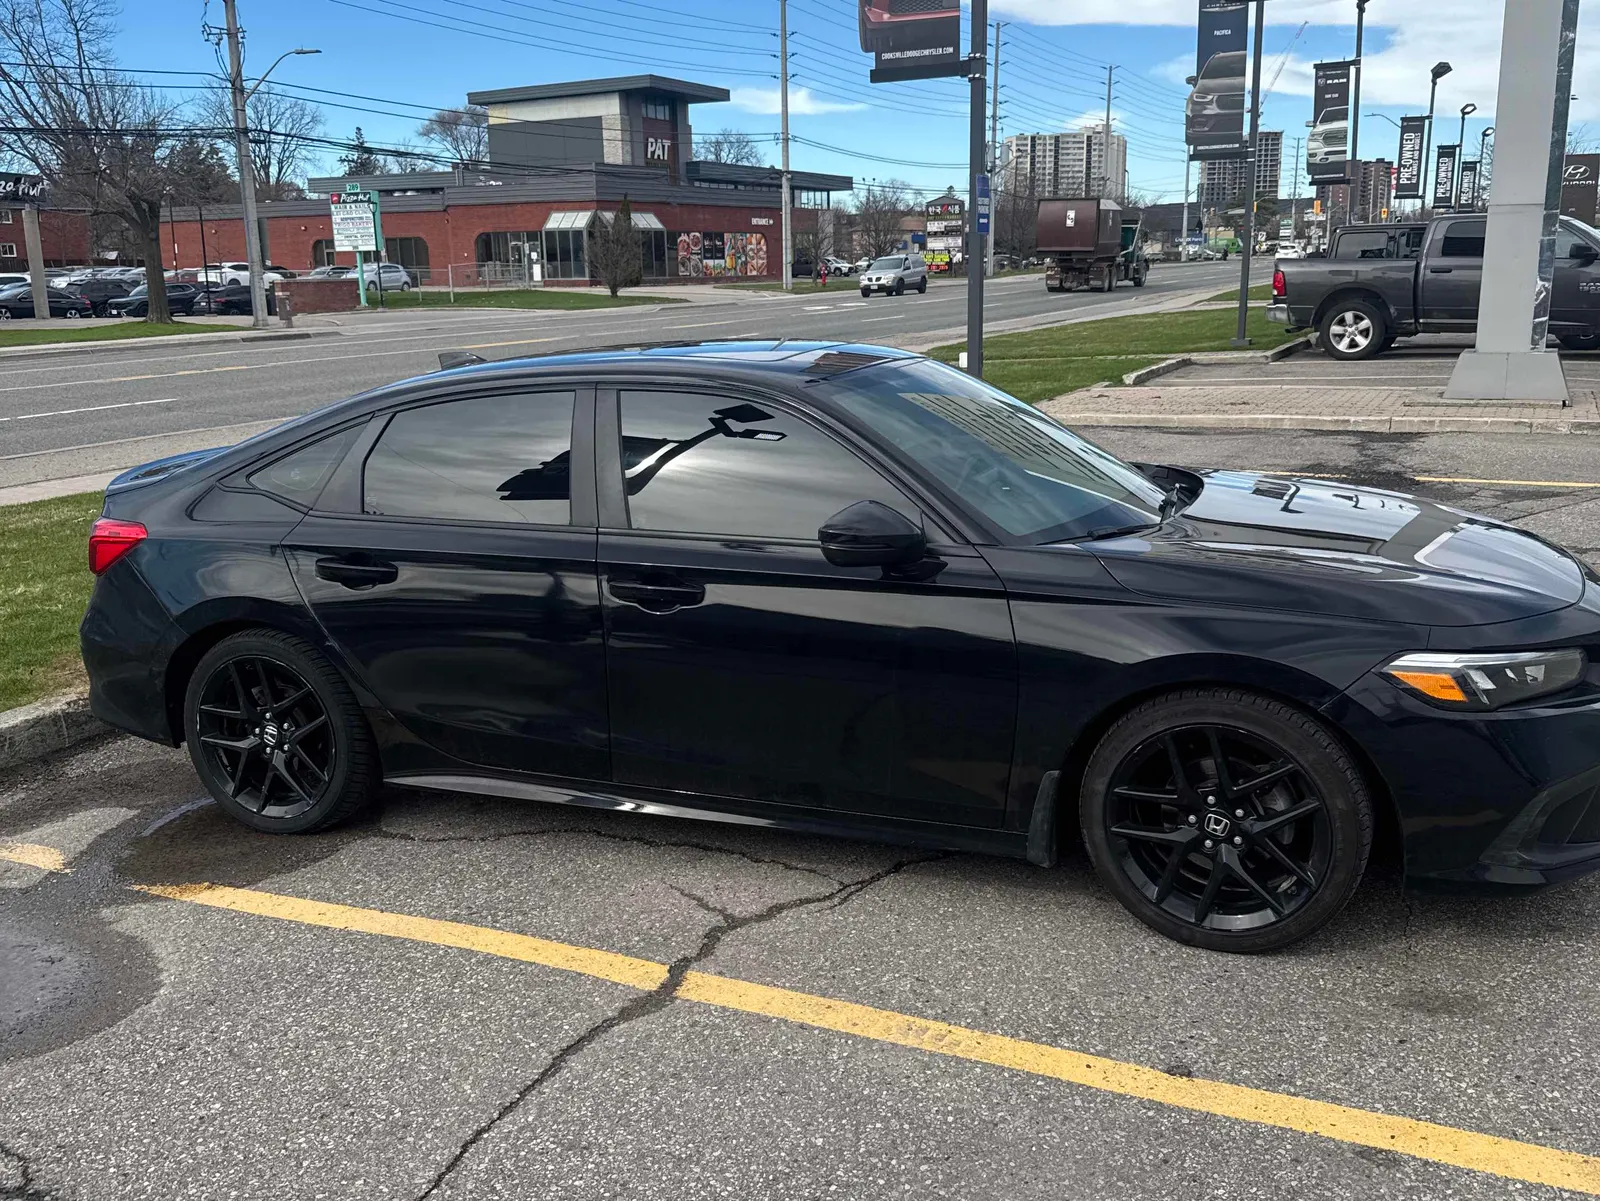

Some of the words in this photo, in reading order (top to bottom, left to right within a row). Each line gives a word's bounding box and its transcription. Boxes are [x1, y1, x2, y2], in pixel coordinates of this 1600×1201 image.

[881, 46, 954, 60] COOKSVILLEDODGECHRYSLER.COM
[647, 137, 671, 160] PAT
[1400, 132, 1415, 184] PRE-OWNED
[347, 183, 359, 191] 289
[1436, 157, 1449, 198] PRE-OWNED
[1460, 170, 1471, 204] PRE-OWNED
[340, 193, 358, 203] Pizza
[357, 192, 370, 202] Hut
